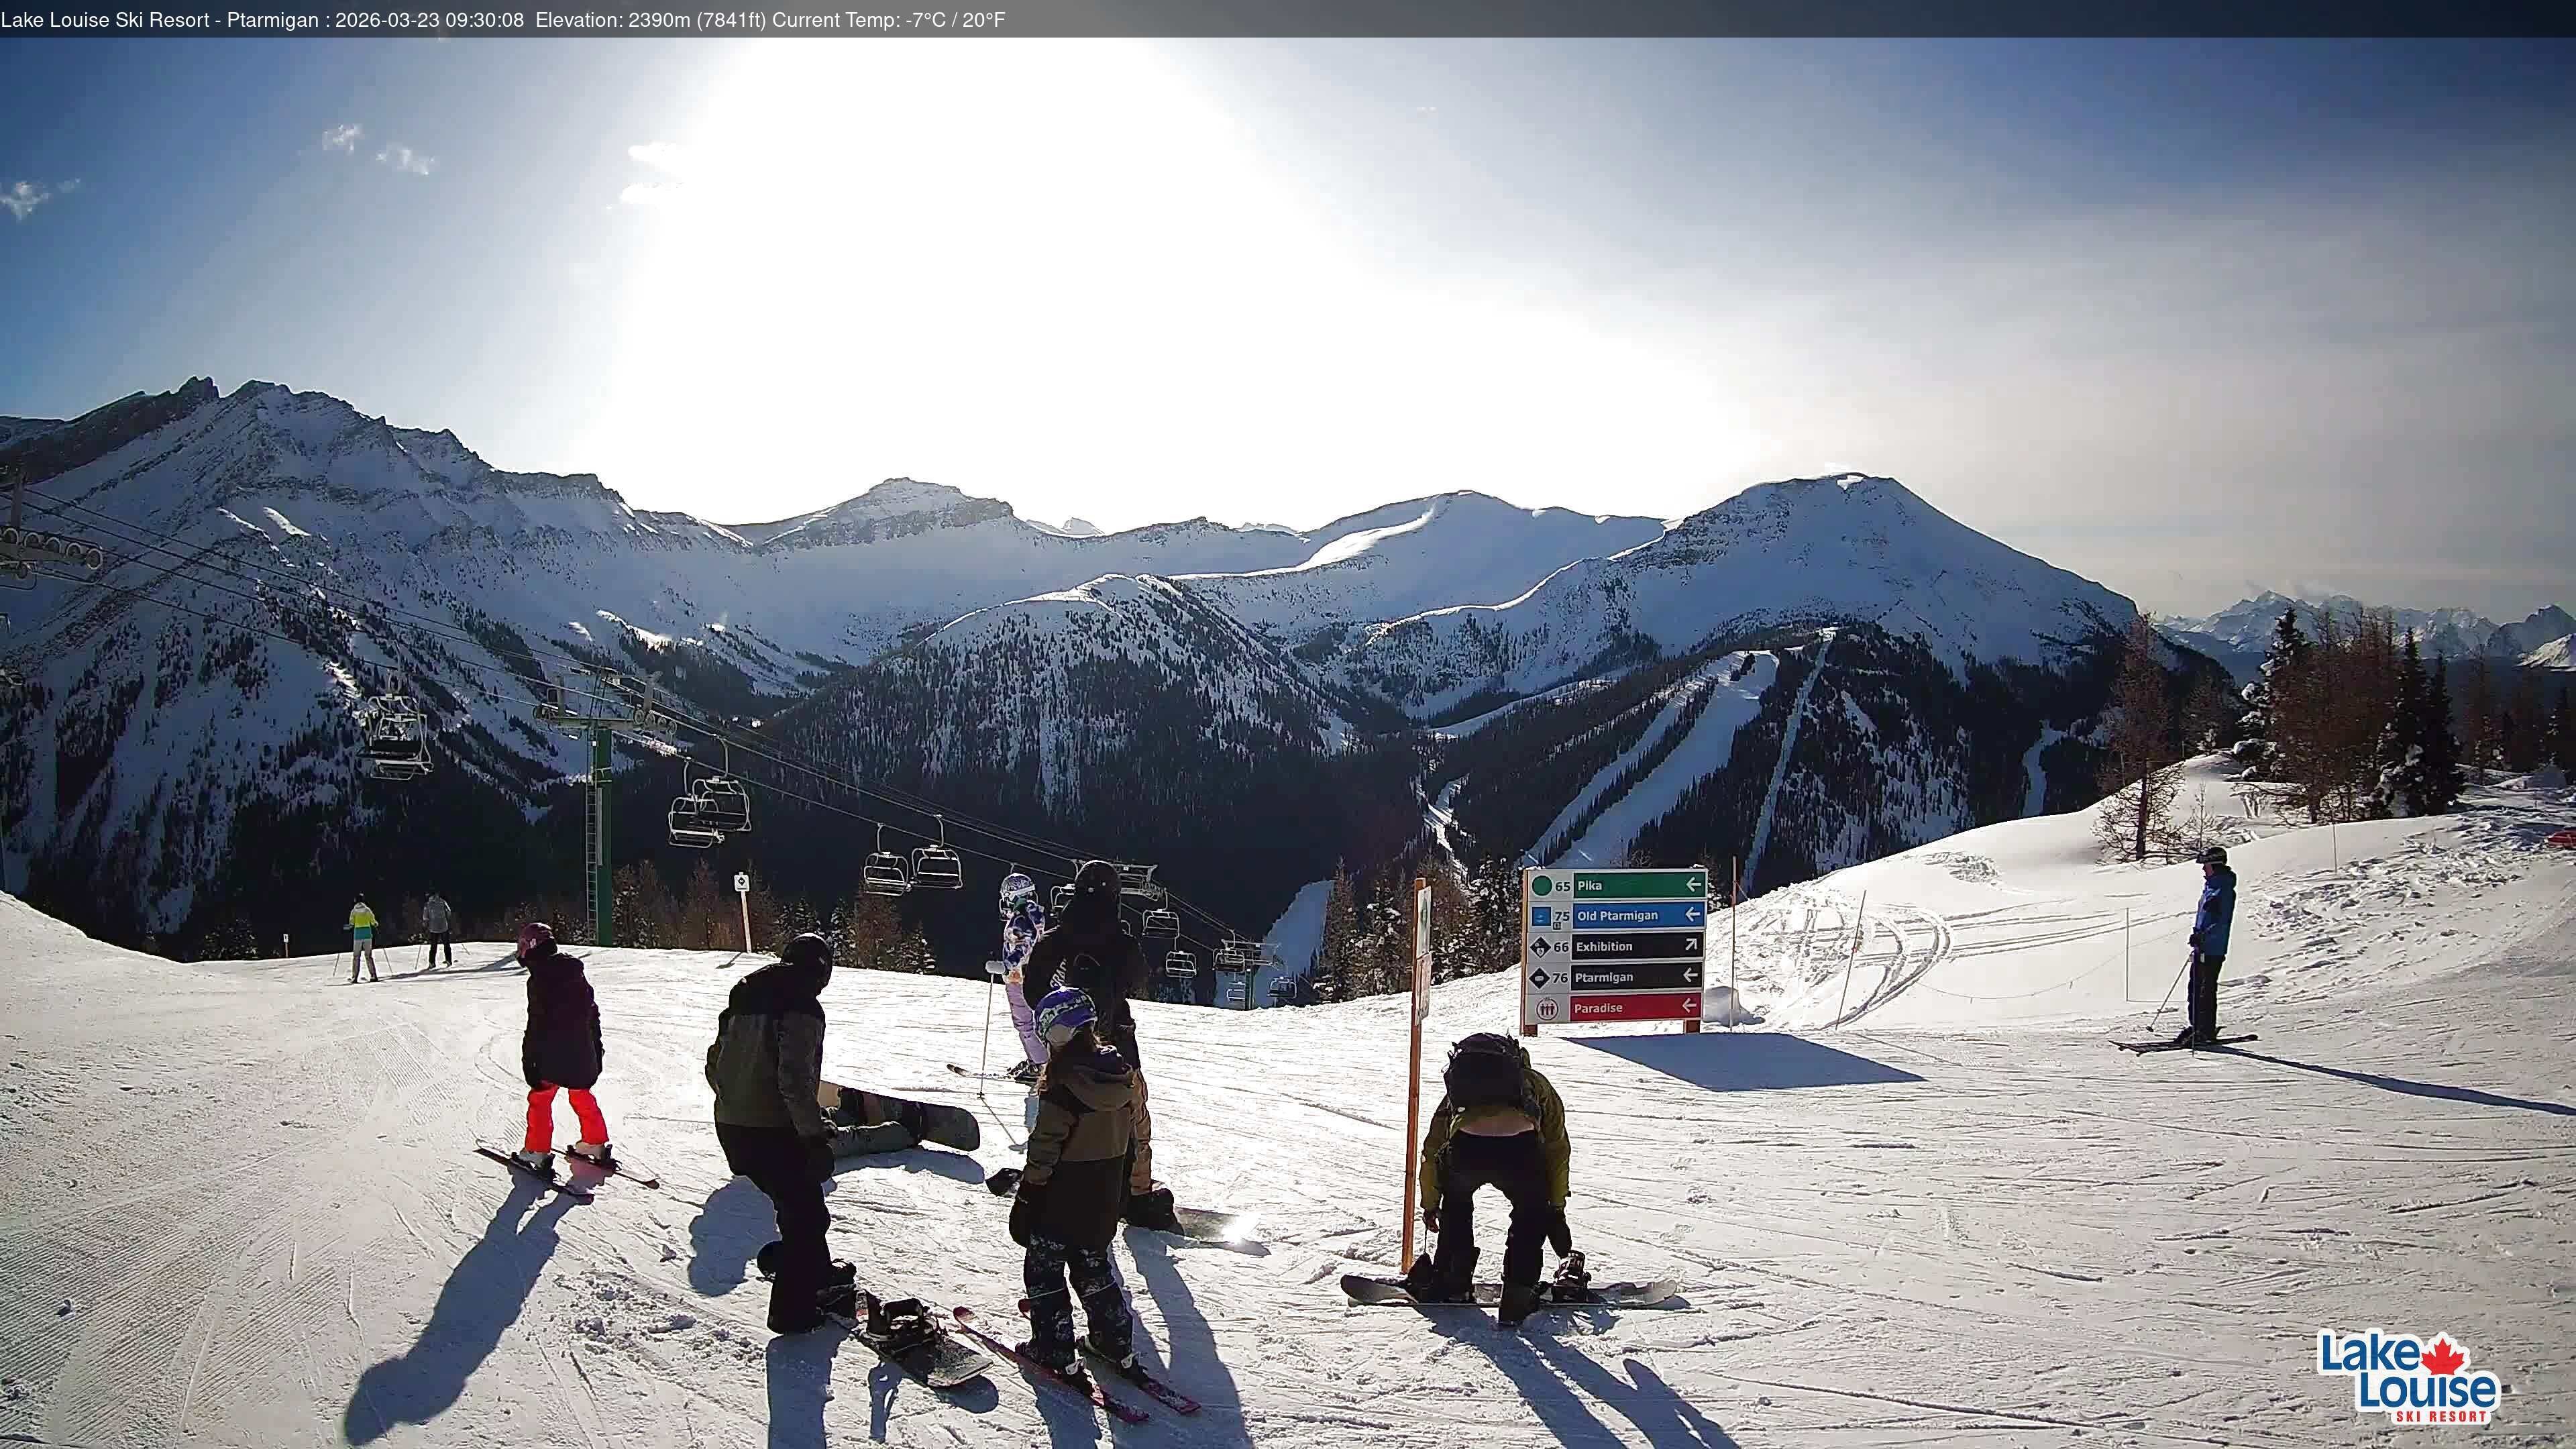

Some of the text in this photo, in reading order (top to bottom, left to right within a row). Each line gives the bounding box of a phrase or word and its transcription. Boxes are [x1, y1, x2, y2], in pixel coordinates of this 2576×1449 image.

[1555, 880, 1603, 892] 65 Pika
[1554, 910, 1658, 922] 75 Old Ptarmigan
[1554, 941, 1633, 953] 66 Exhibition
[1552, 972, 1633, 983] 76 Ptarmigan
[1574, 1004, 1623, 1014] Paradise
